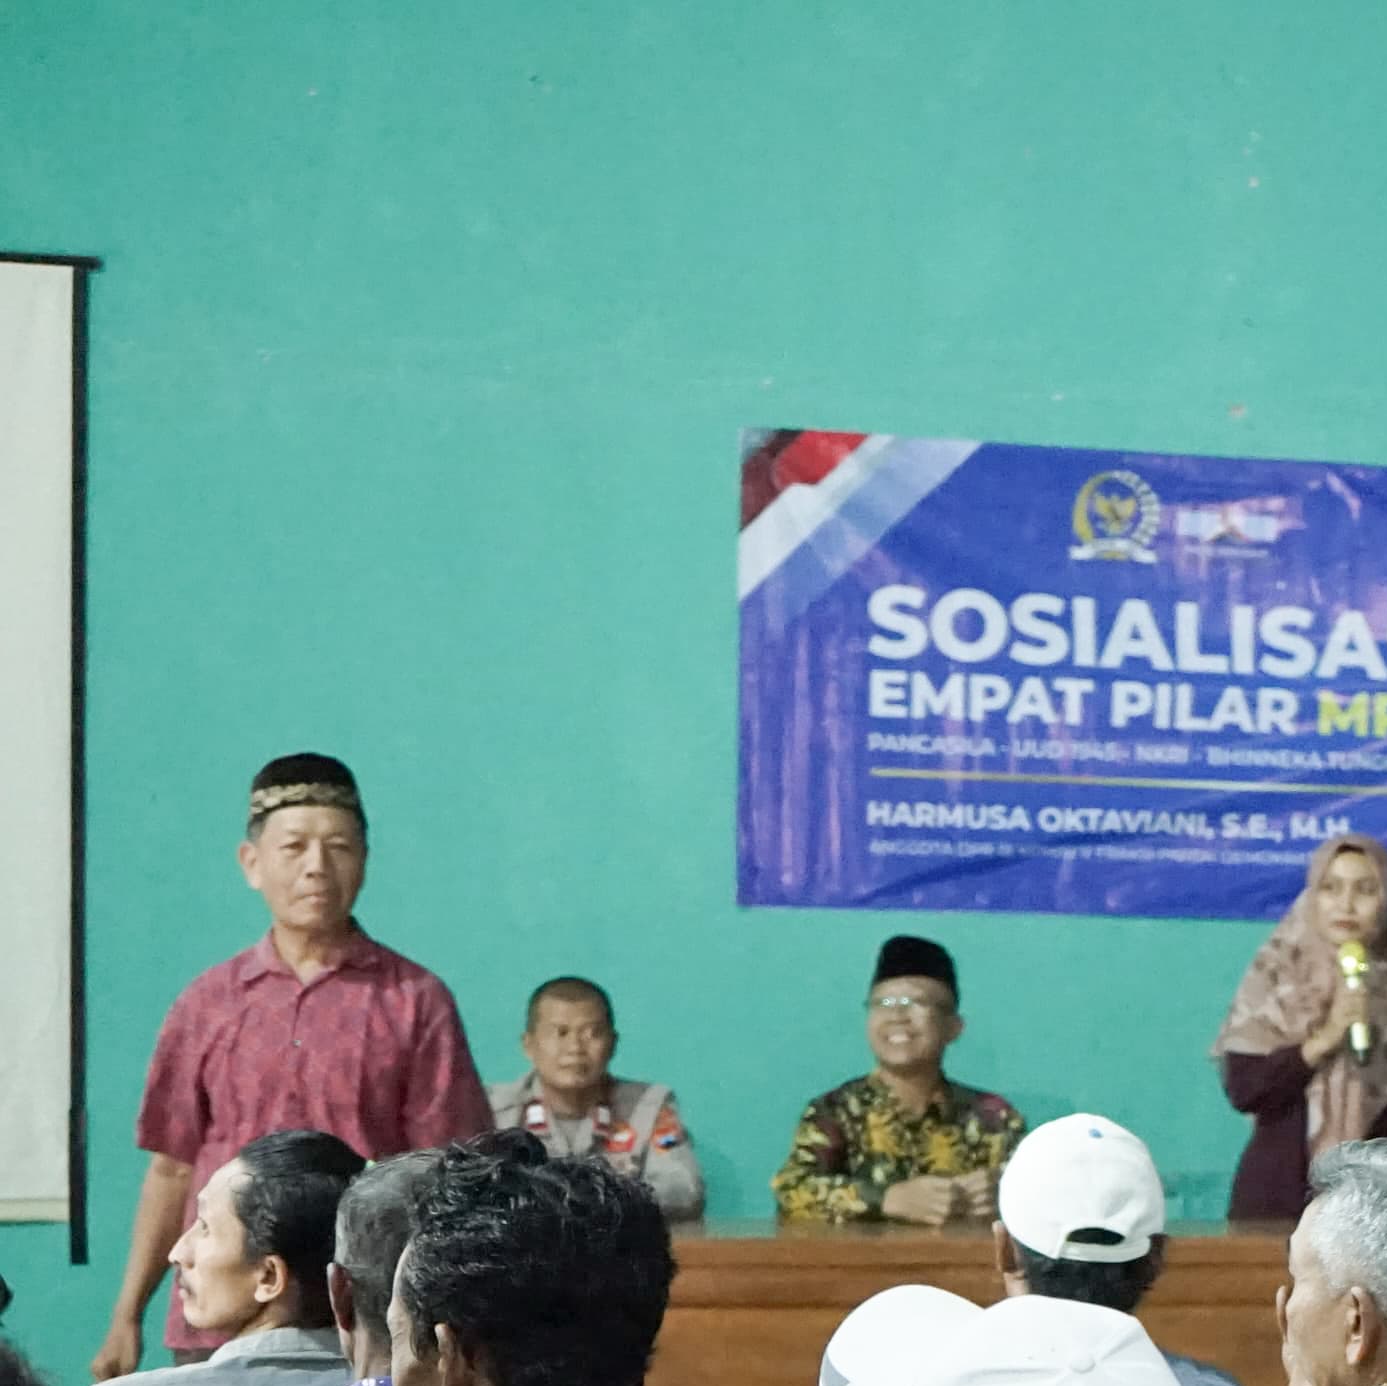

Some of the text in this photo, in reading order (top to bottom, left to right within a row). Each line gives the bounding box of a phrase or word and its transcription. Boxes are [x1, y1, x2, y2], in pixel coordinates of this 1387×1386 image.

[869, 669, 1095, 727] EMPAT
[1110, 680, 1299, 736] PILAR
[866, 801, 1031, 831] HARMUSA
[1038, 806, 1216, 840] OKTAVIANI,
